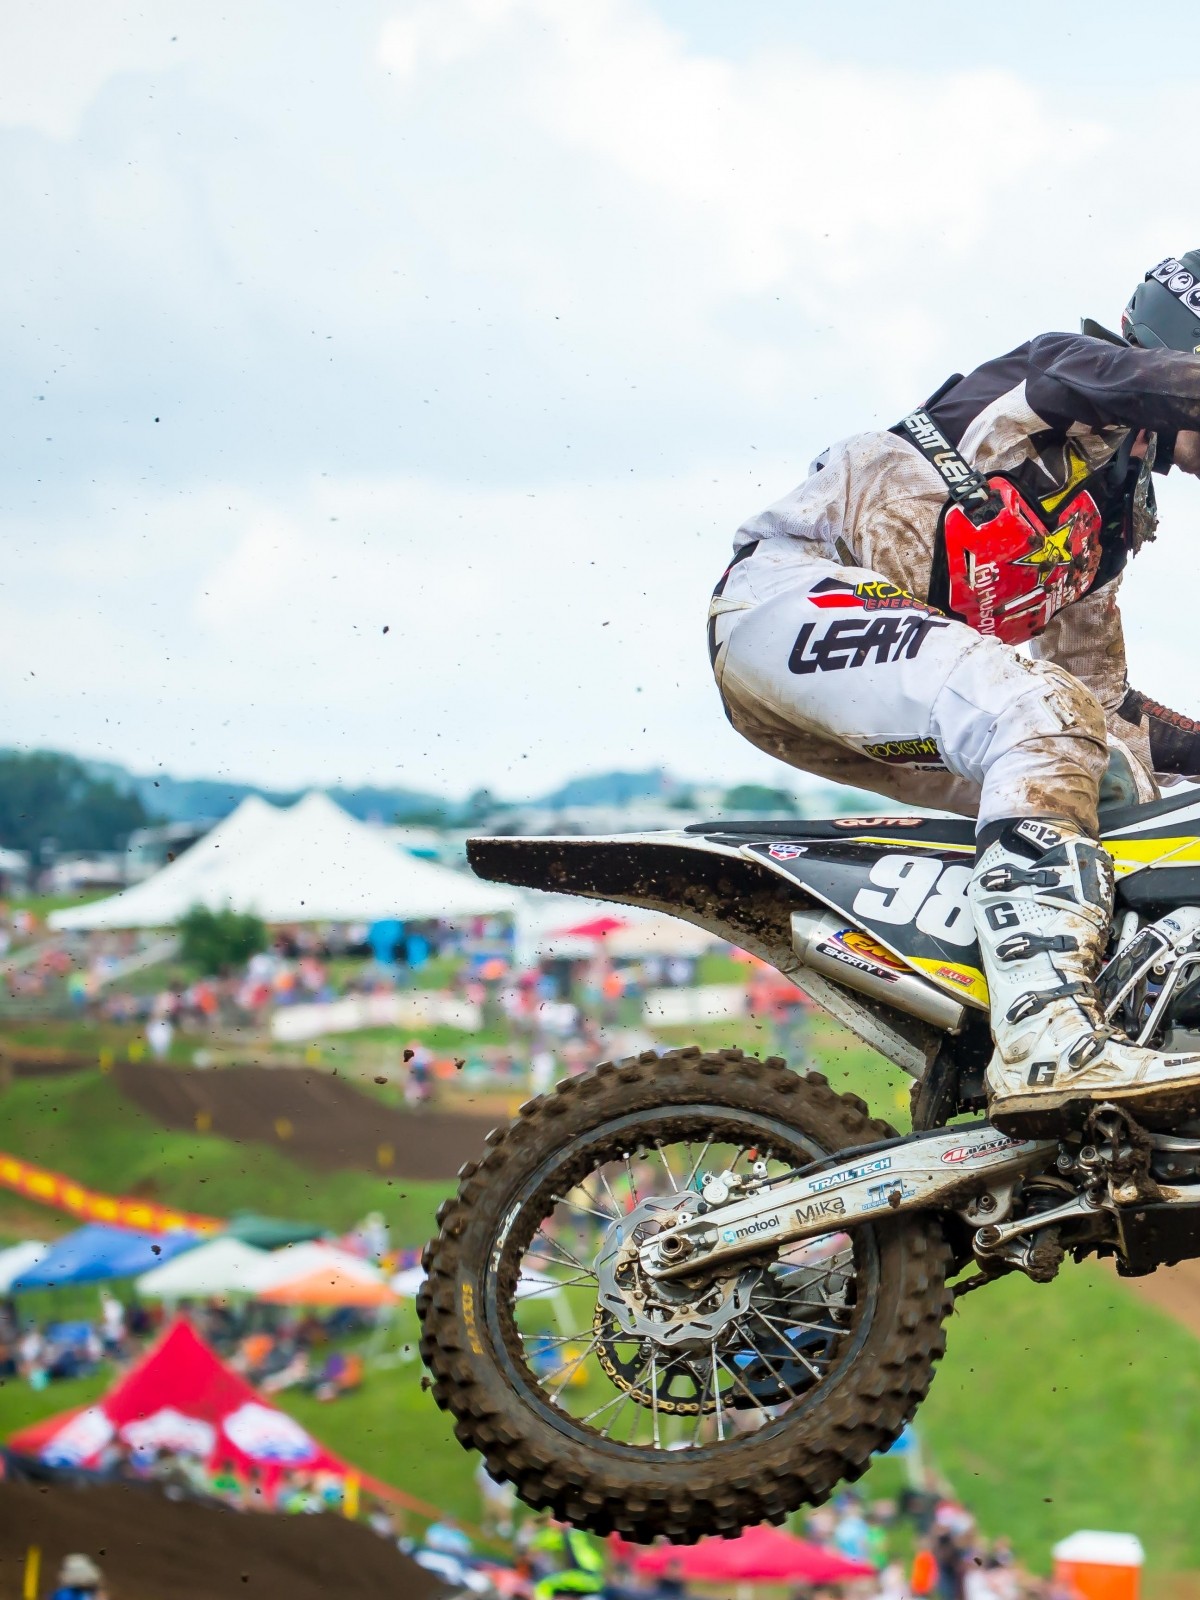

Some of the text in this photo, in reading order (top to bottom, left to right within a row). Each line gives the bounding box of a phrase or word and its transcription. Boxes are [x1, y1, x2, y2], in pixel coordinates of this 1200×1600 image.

[977, 585, 996, 635] Husqv
[788, 615, 951, 675] LEATT
[834, 818, 923, 826] GUTS
[853, 854, 978, 946] 98
[823, 947, 877, 972] SHORTY
[808, 1157, 891, 1192] TRAIL TECH
[795, 1197, 845, 1224] Mika
[736, 1215, 780, 1238] motool
